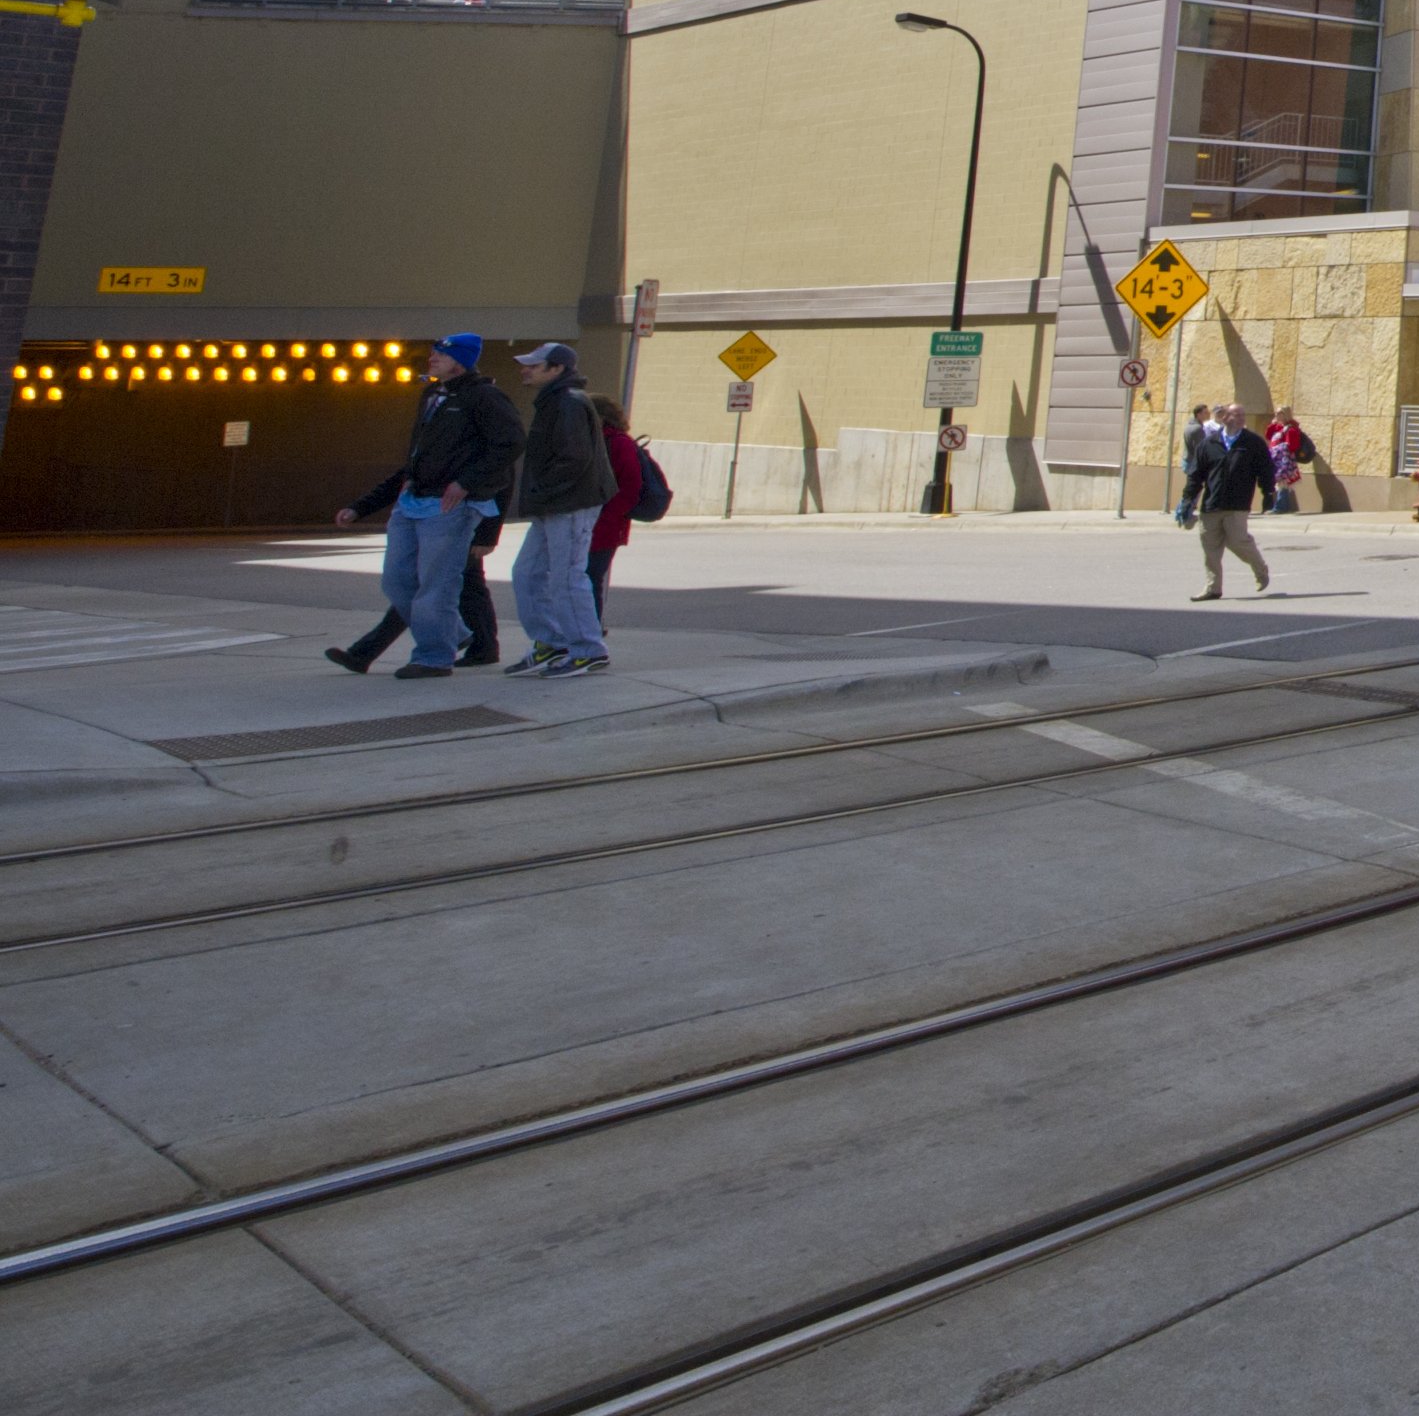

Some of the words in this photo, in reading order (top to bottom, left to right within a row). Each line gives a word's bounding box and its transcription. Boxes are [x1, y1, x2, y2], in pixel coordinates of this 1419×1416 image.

[109, 272, 131, 287] 14
[134, 277, 152, 287] FT
[167, 272, 180, 287] 3
[183, 277, 198, 287] IN
[940, 334, 976, 342] FREEWAY
[936, 344, 977, 352] ENTRANCE
[735, 384, 747, 392] NO
